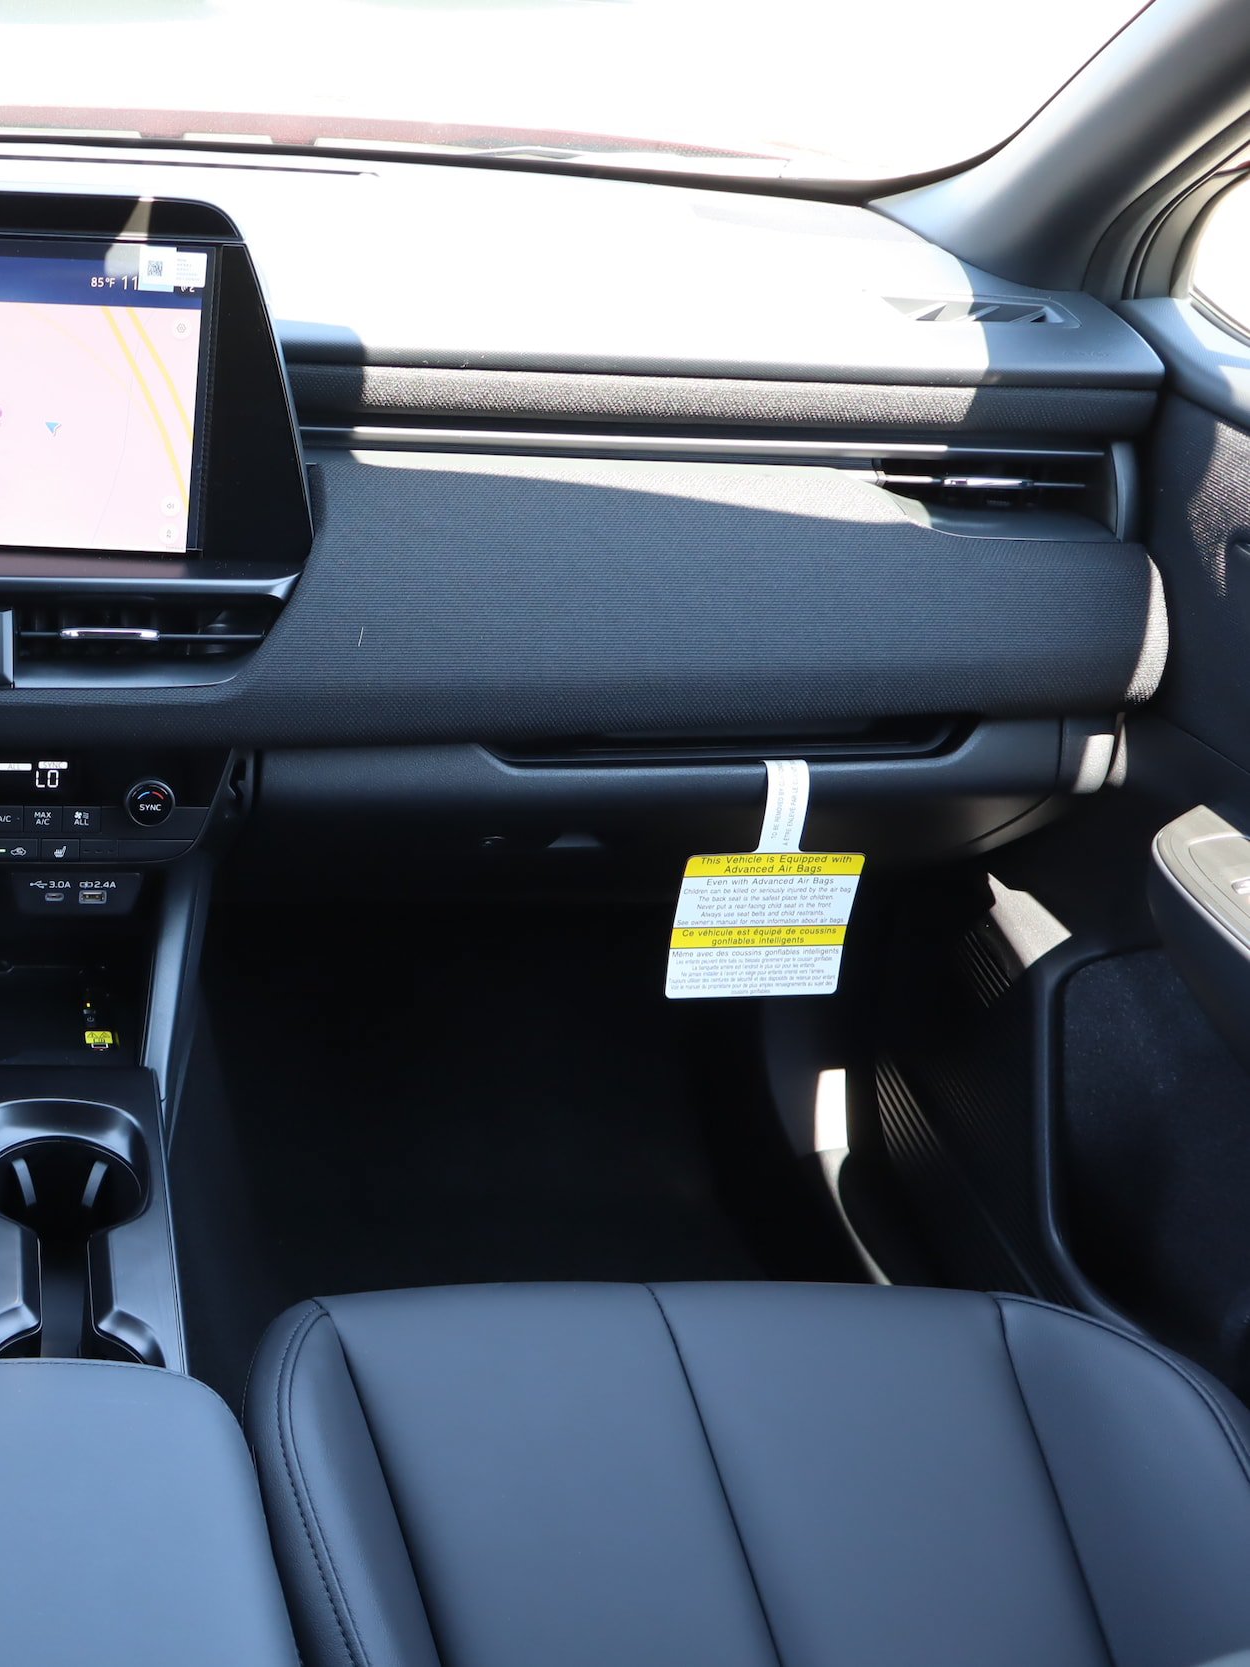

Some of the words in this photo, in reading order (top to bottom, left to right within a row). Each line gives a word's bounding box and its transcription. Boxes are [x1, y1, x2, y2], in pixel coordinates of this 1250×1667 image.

[90, 277, 116, 288] 85°F
[35, 769, 59, 788] LO
[139, 804, 162, 812] SYNC
[34, 811, 52, 819] MAX
[35, 818, 50, 826] A/C
[73, 818, 89, 826] ALL
[726, 856, 762, 864] Vehicle
[779, 855, 828, 864] Equipped
[831, 855, 852, 863] with
[724, 865, 775, 873] Advanced
[779, 864, 792, 873] Air
[796, 864, 822, 875] Bags
[48, 880, 71, 889] 3.0A
[94, 880, 116, 889] 2.4A
[813, 877, 834, 886] Bags
[682, 929, 694, 937] Ce
[699, 928, 733, 937] véhicule
[737, 928, 750, 936] est
[753, 927, 782, 938] équipé
[785, 927, 796, 935] de
[799, 927, 837, 935] coussins
[711, 937, 756, 947] gonflables
[758, 936, 805, 946] intelligents
